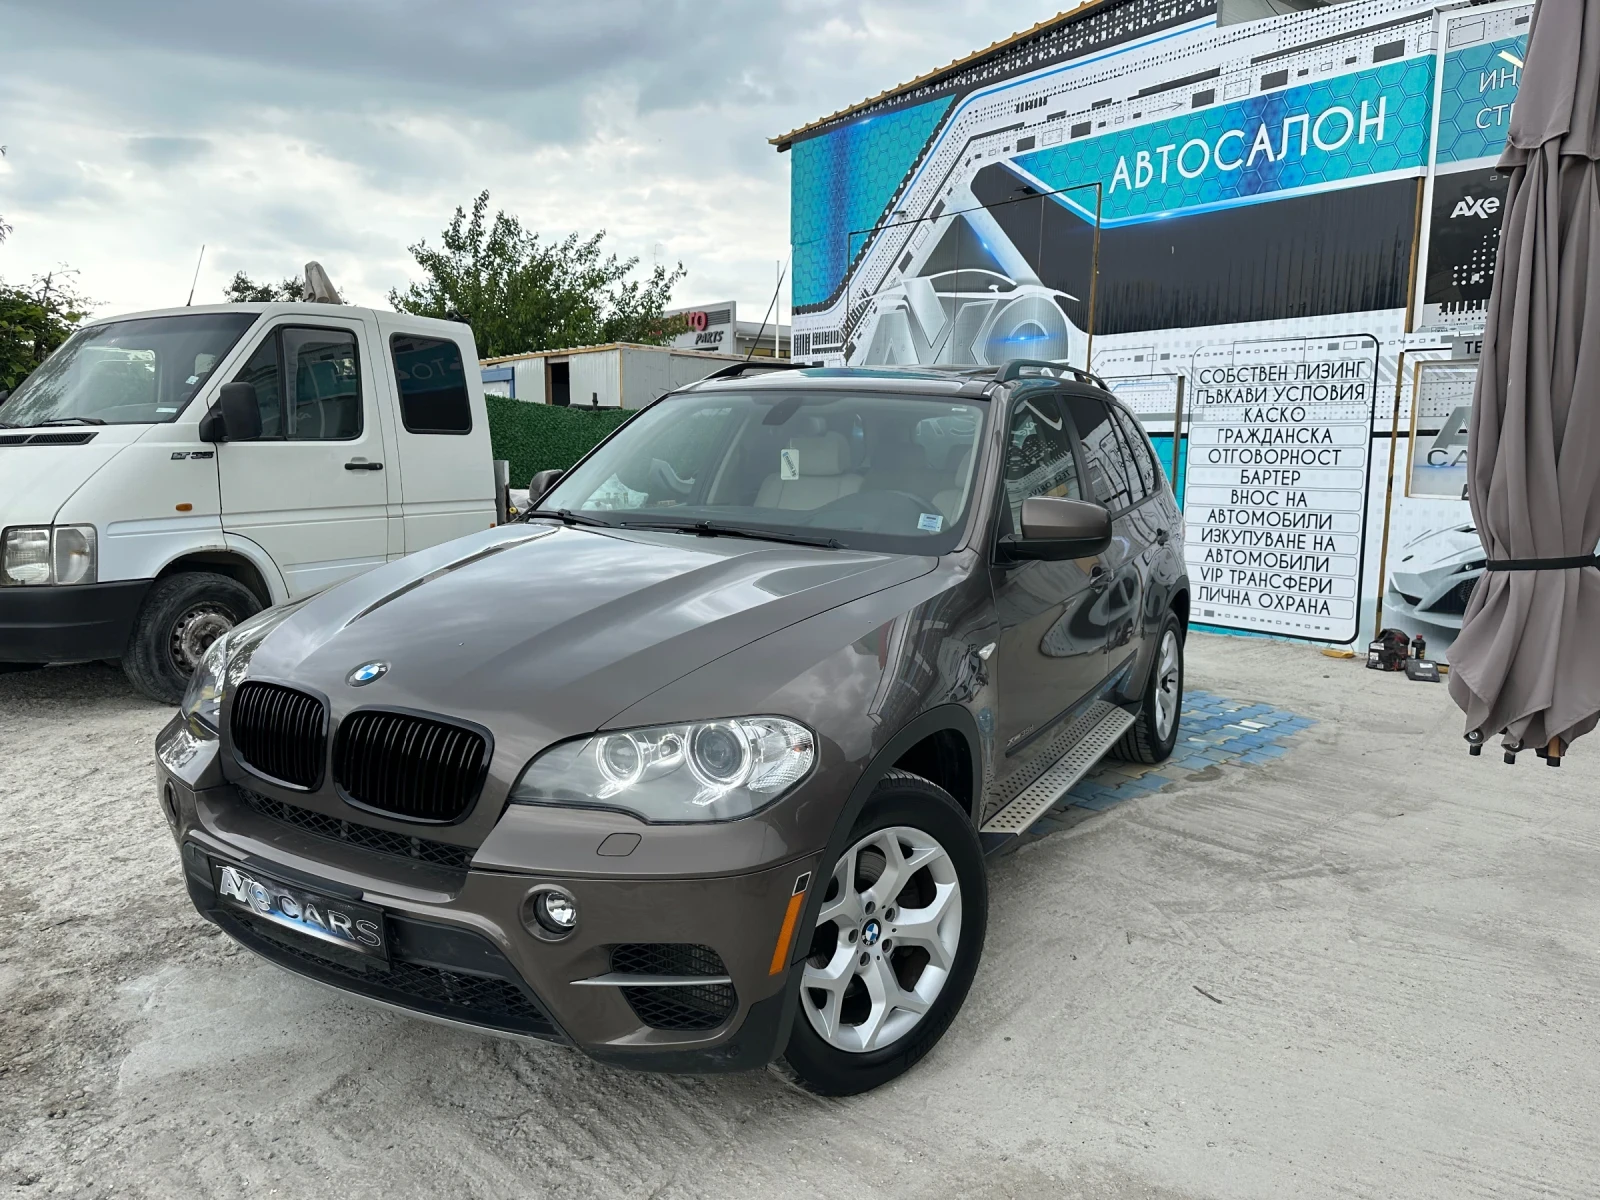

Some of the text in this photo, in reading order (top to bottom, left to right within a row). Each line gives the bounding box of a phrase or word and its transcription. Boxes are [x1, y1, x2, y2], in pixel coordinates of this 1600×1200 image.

[1108, 96, 1387, 194] АВТОСАЛОН
[695, 331, 724, 345] PARTS
[1200, 361, 1366, 384] СОБСТВЕН ЛИЗИНГ
[1196, 383, 1365, 405] ГЪВКАВИ УСЛОВИЯ
[1243, 407, 1306, 423] КАСКО
[1217, 428, 1333, 446] ГРАЖДАНСКА
[170, 451, 214, 460] LT 35
[1208, 448, 1342, 466] ОТГОВОРНОСТ
[1240, 469, 1301, 486] БАРТЕР
[1231, 489, 1308, 508] ВНОС НА
[1207, 508, 1333, 530] АВТОМОБИЛИ
[1201, 528, 1336, 552] ИЗКУПУВАНЕ НА
[1204, 548, 1329, 573] АВТОМОБИЛИ
[1200, 567, 1333, 595] VIP ТРАНСФЕРИ
[1198, 586, 1331, 616] ЛИЧНА ОХРАНА
[277, 894, 381, 947] CARS
